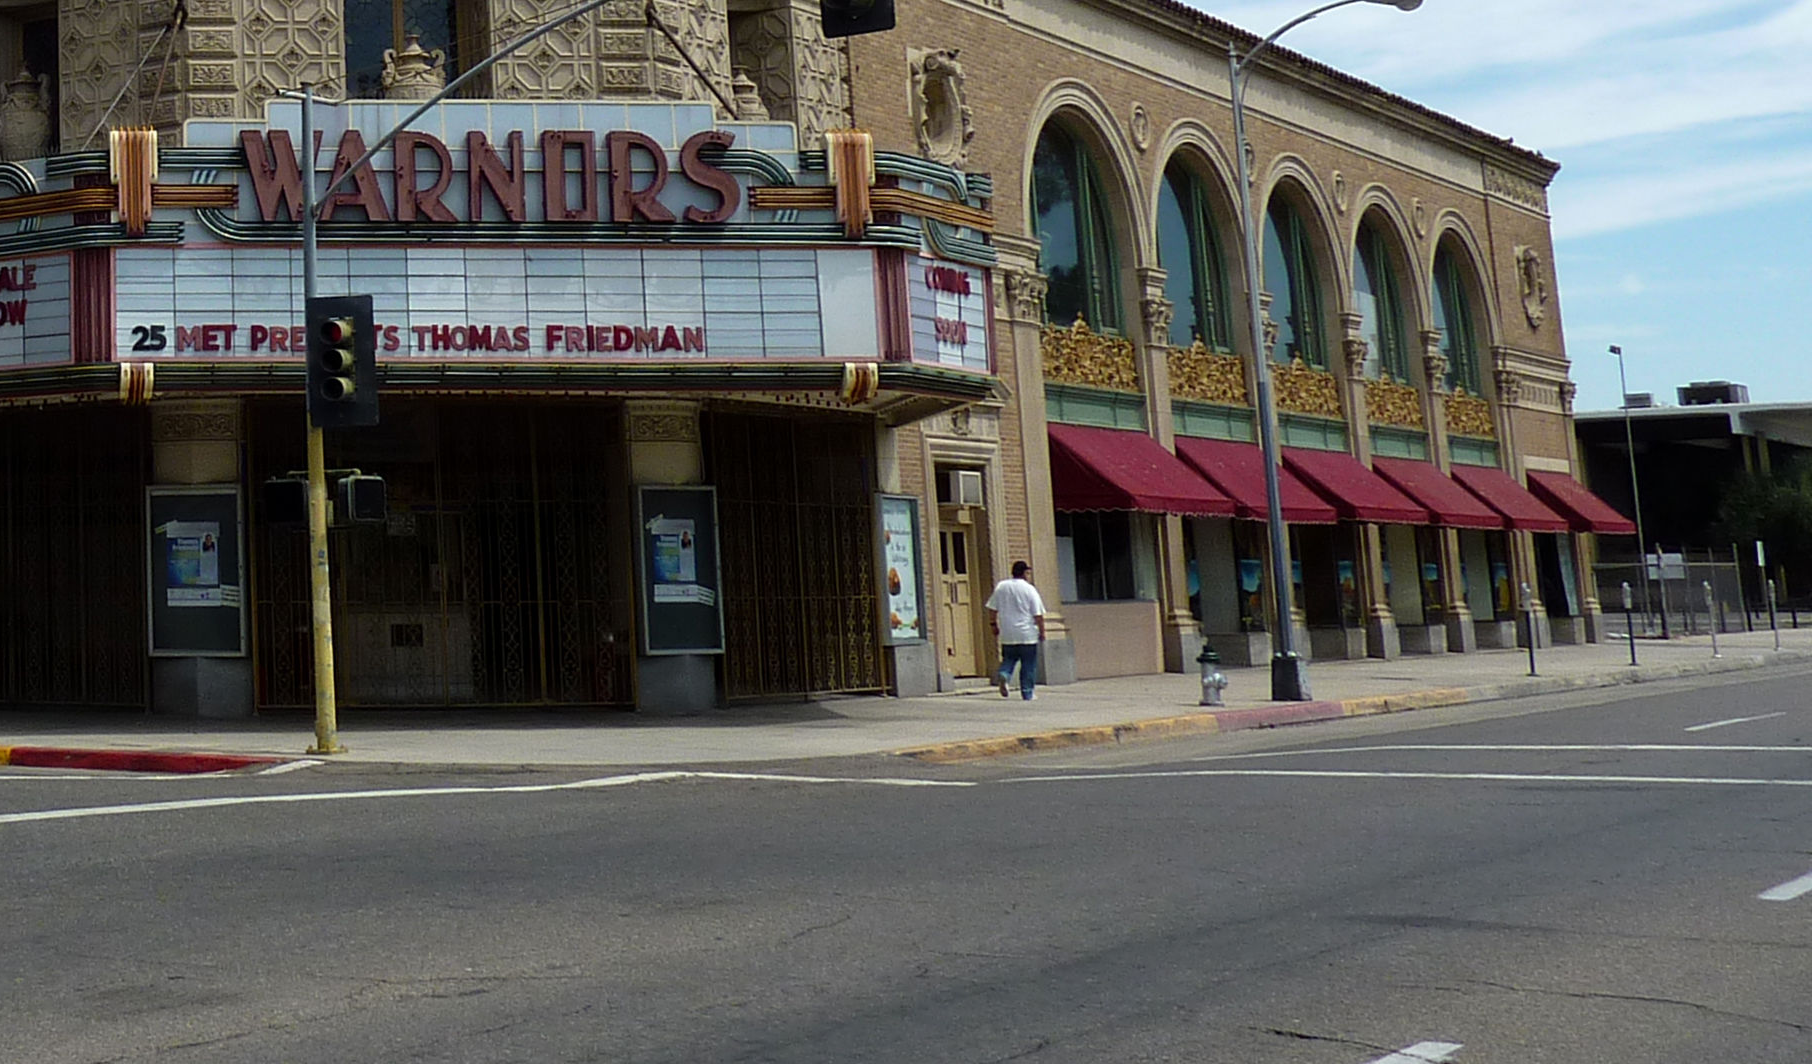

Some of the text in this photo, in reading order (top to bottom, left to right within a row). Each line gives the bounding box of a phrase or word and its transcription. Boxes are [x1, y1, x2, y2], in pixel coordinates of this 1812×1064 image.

[239, 129, 742, 223] WARNORS
[131, 325, 168, 352] 25
[175, 324, 237, 352] MET
[411, 324, 530, 352] THOMAS
[546, 324, 704, 353] FRIEDMAN
[934, 317, 968, 346] SOON
